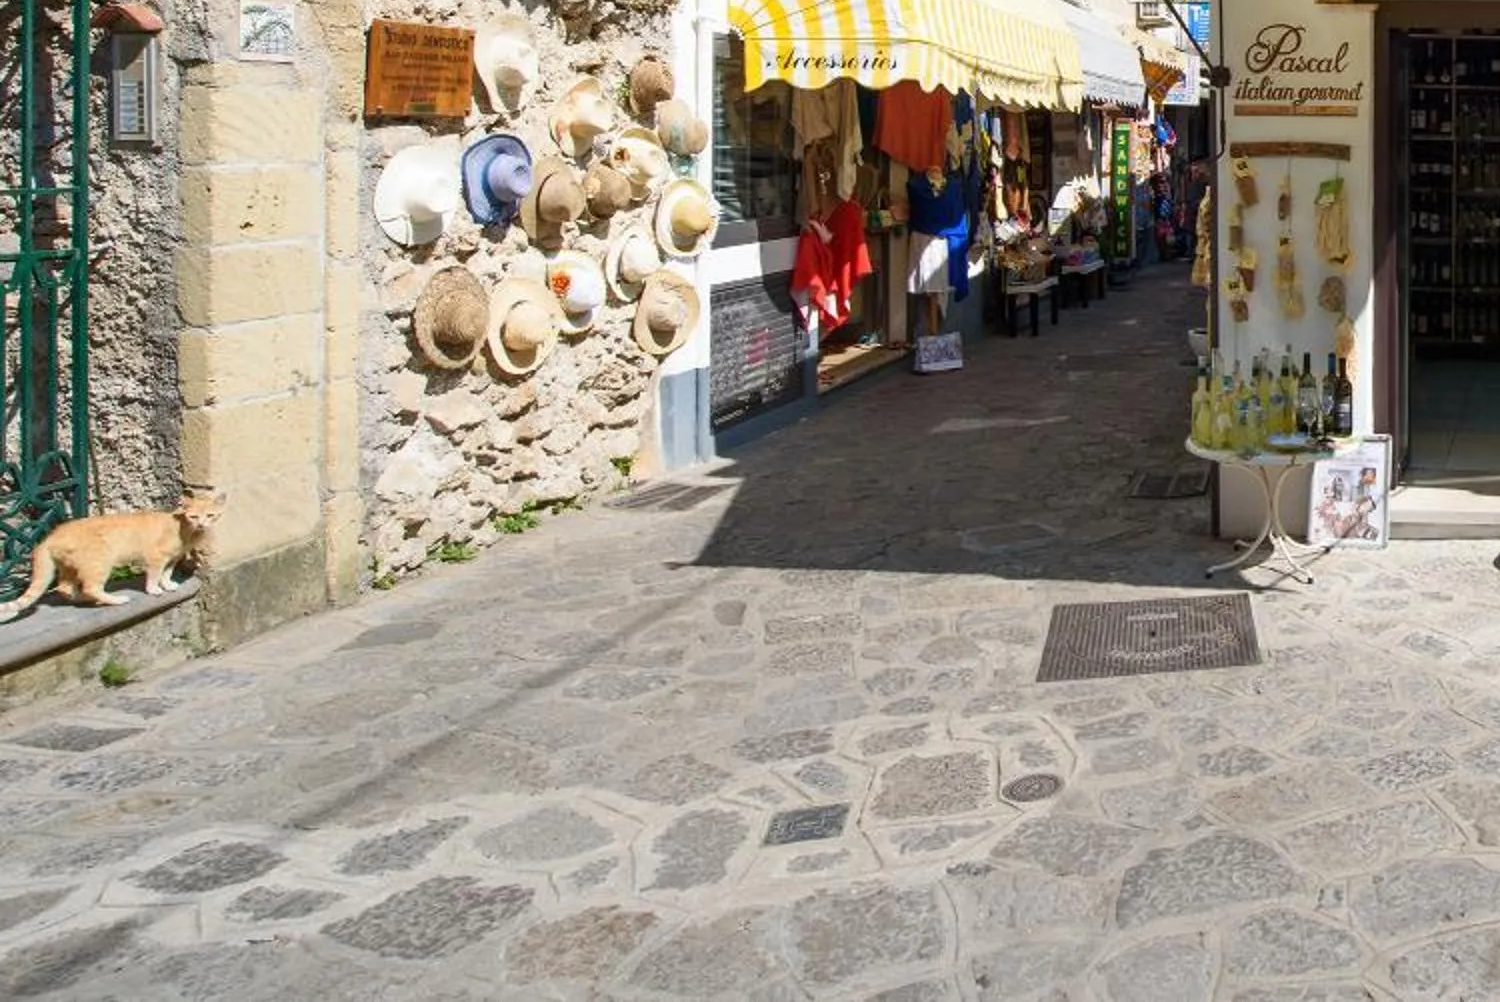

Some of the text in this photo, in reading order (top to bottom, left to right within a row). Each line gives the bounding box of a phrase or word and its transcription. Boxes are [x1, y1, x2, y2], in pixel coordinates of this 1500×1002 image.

[766, 46, 897, 70] Accessories
[1245, 23, 1349, 73] Pascal
[1233, 75, 1364, 107] italian gourmet
[1115, 134, 1128, 253] SANDWICH
